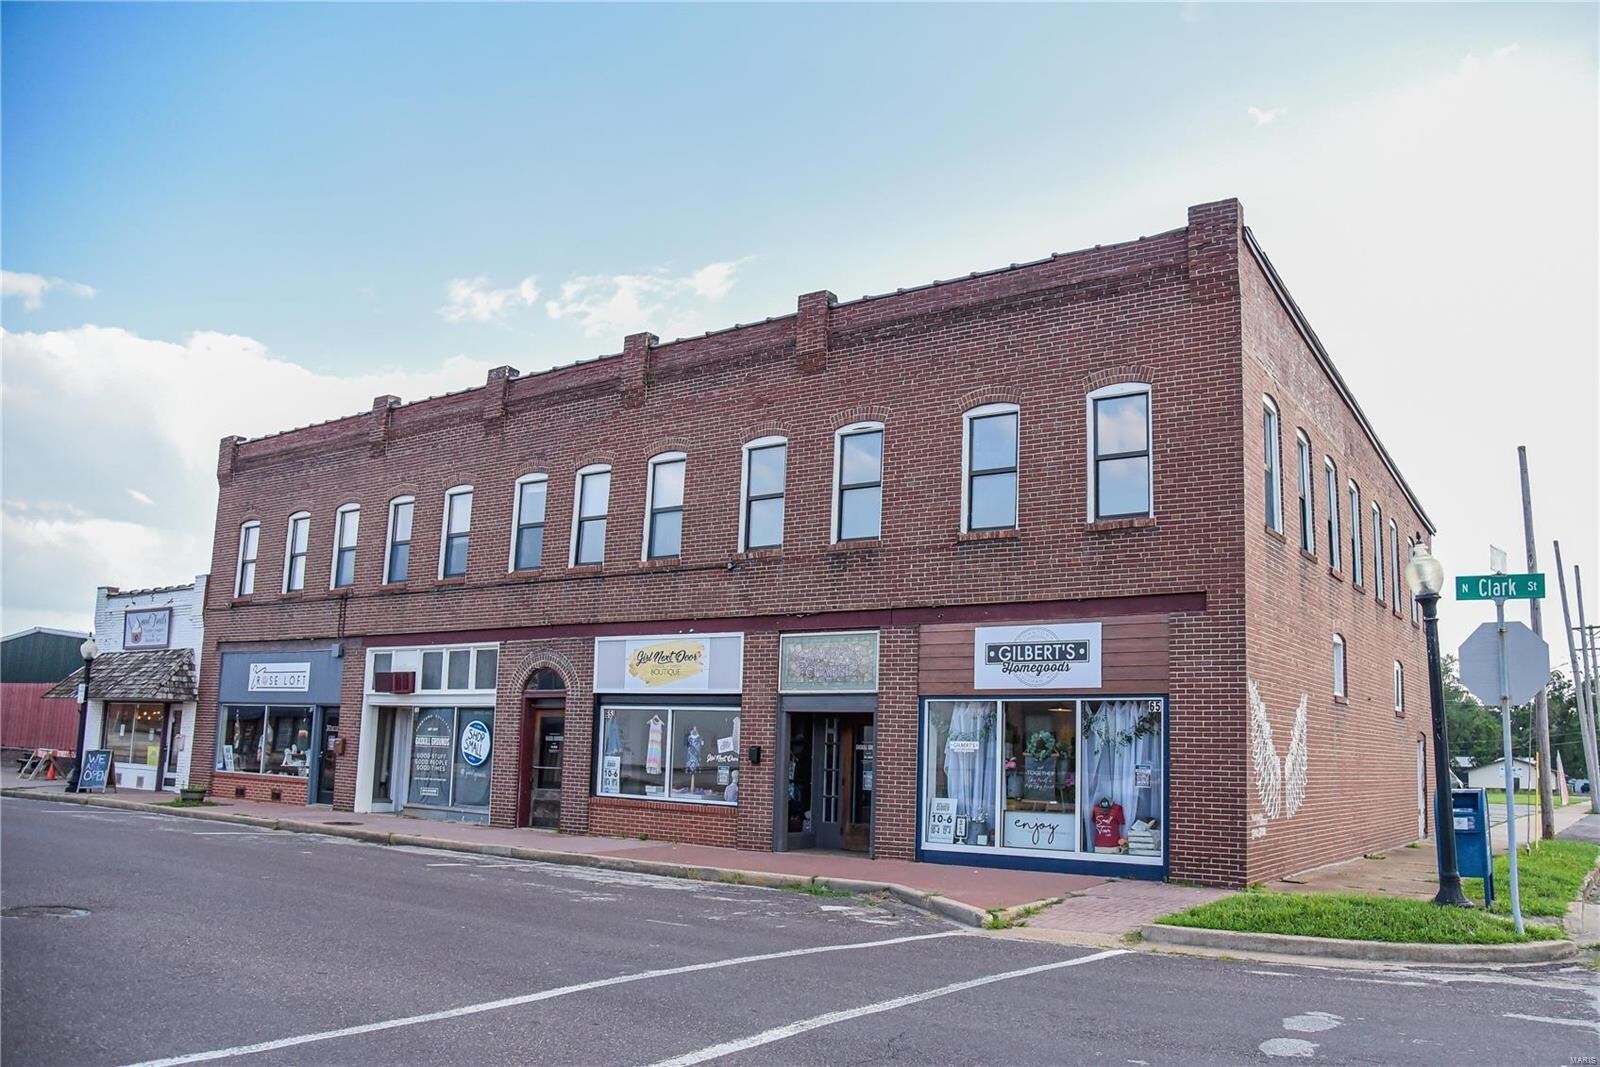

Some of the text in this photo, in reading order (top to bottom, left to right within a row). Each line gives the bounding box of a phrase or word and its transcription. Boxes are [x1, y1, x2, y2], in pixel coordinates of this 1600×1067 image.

[1462, 578, 1537, 597] N Clark St
[636, 650, 697, 666] Girl Next Door
[998, 644, 1076, 661] GILBERT'S
[650, 668, 680, 676] BOUTIQUE
[1001, 661, 1071, 677] Homegoods
[283, 675, 306, 686] LOFT
[1149, 701, 1161, 712] 65
[468, 728, 486, 742] SHOP
[464, 738, 482, 757] SMALL
[88, 753, 106, 764] WE
[931, 814, 953, 824] 10-6
[1014, 818, 1060, 846] enjoy
